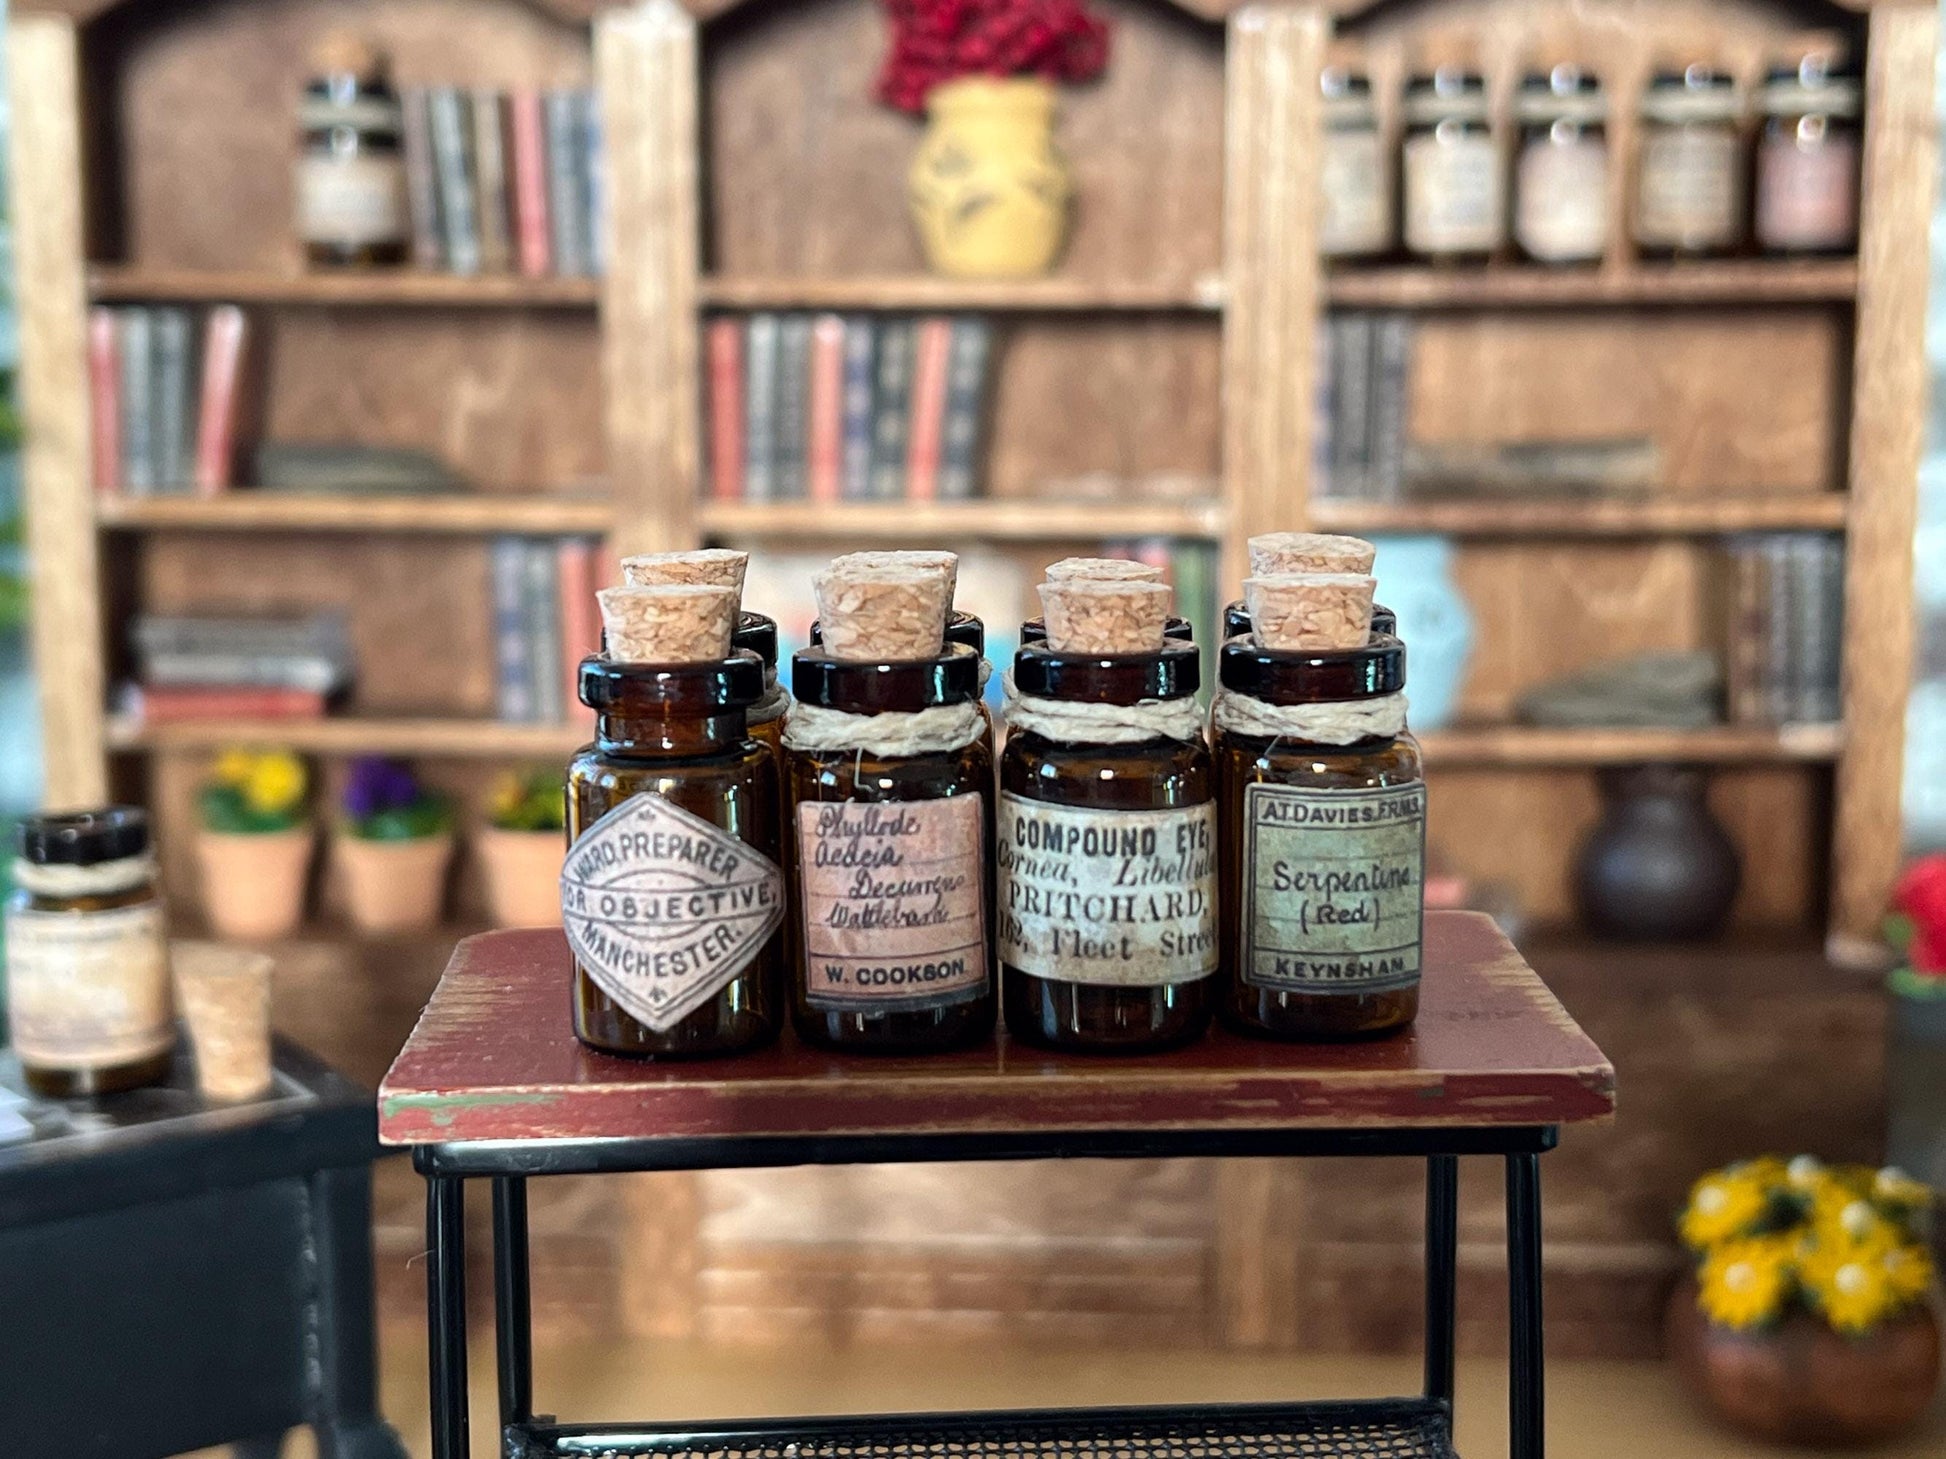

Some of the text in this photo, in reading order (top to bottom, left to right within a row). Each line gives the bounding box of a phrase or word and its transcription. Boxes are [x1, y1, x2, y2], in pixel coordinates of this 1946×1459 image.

[620, 832, 739, 880] PREPARER
[1016, 816, 1156, 857] COMPOUND
[1273, 860, 1410, 902] Serpentine
[1300, 898, 1380, 935] (Red)
[581, 921, 742, 977] MANCHESTER.
[1052, 927, 1133, 960] Fleet
[826, 958, 965, 985] W. COOKSON
[1275, 957, 1405, 978] KEYNSHAM
